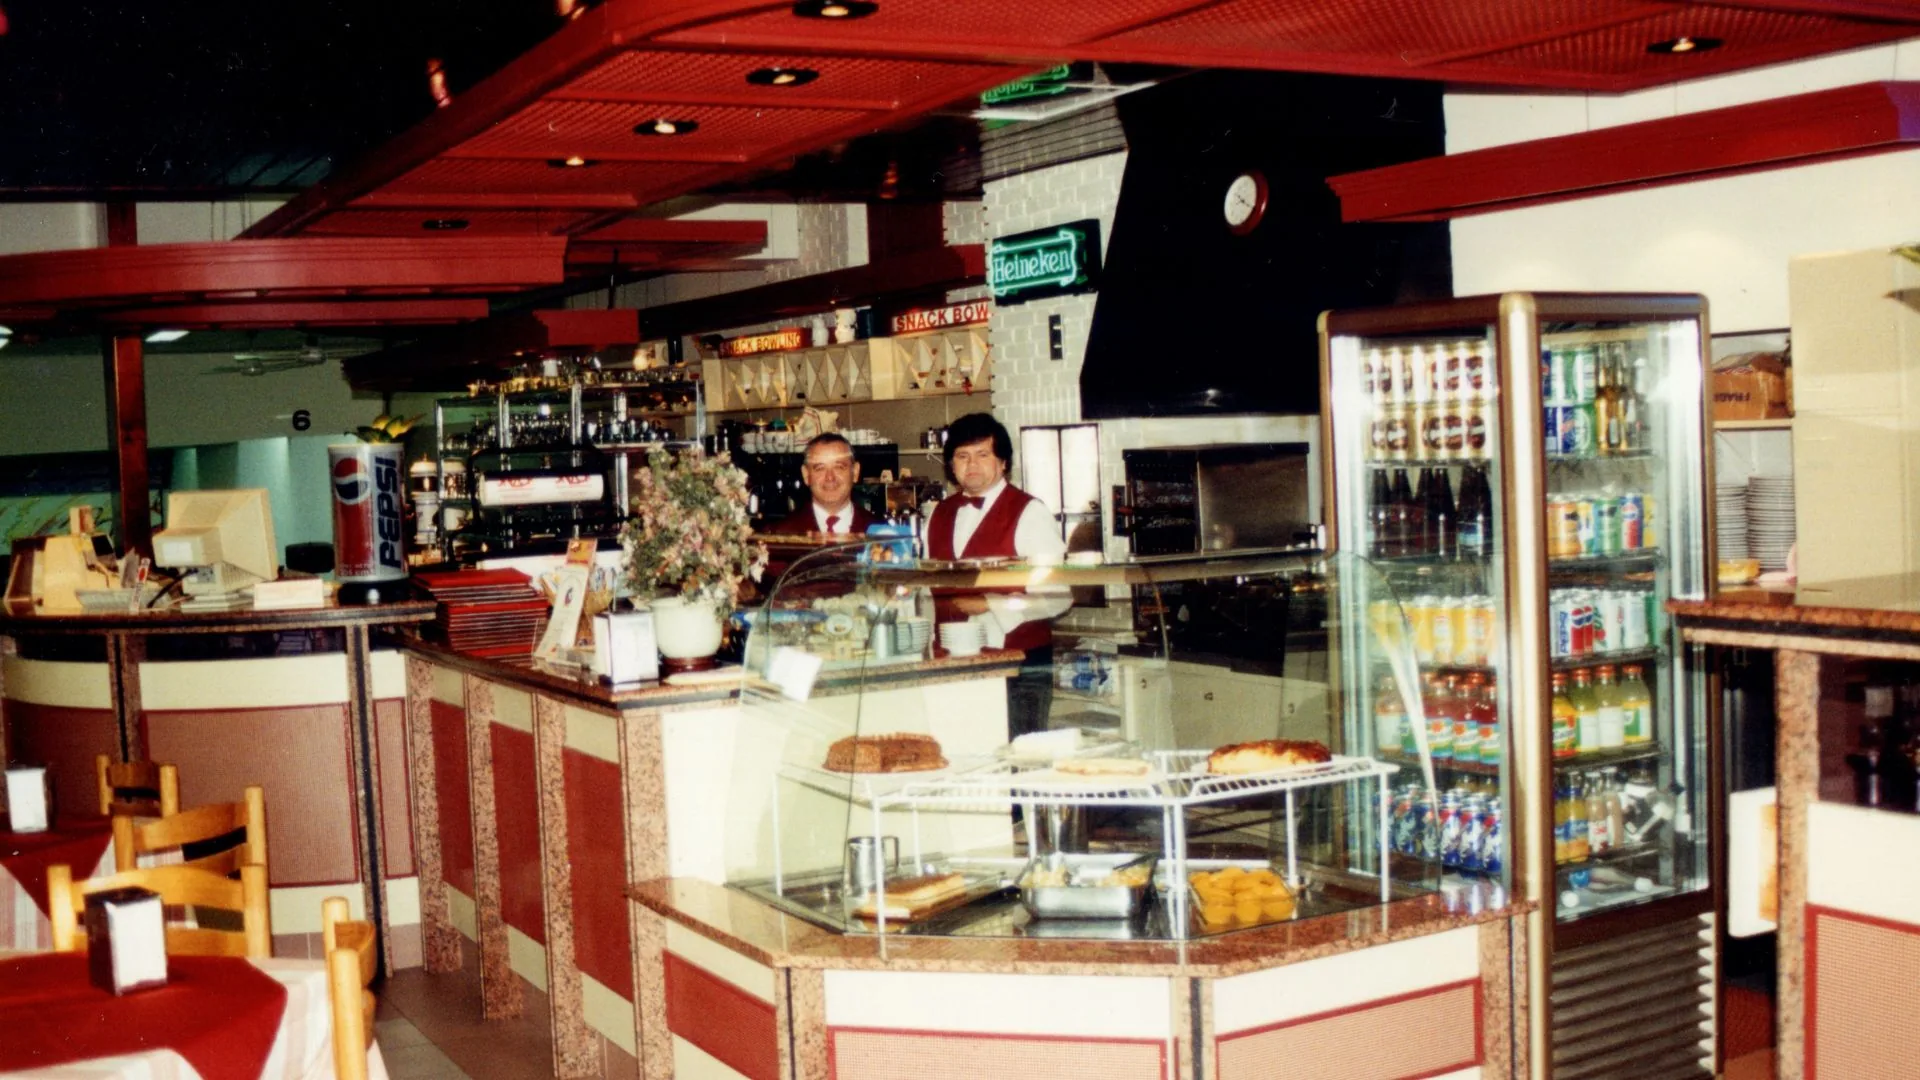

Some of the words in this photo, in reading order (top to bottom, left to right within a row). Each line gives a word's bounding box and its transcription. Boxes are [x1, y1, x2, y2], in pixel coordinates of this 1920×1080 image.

[993, 248, 1071, 283] Heineken
[896, 310, 949, 331] SNACK
[953, 302, 988, 323] BOW
[756, 330, 801, 351] BOWLING
[292, 409, 311, 431] 6
[375, 455, 402, 569] PEPSI
